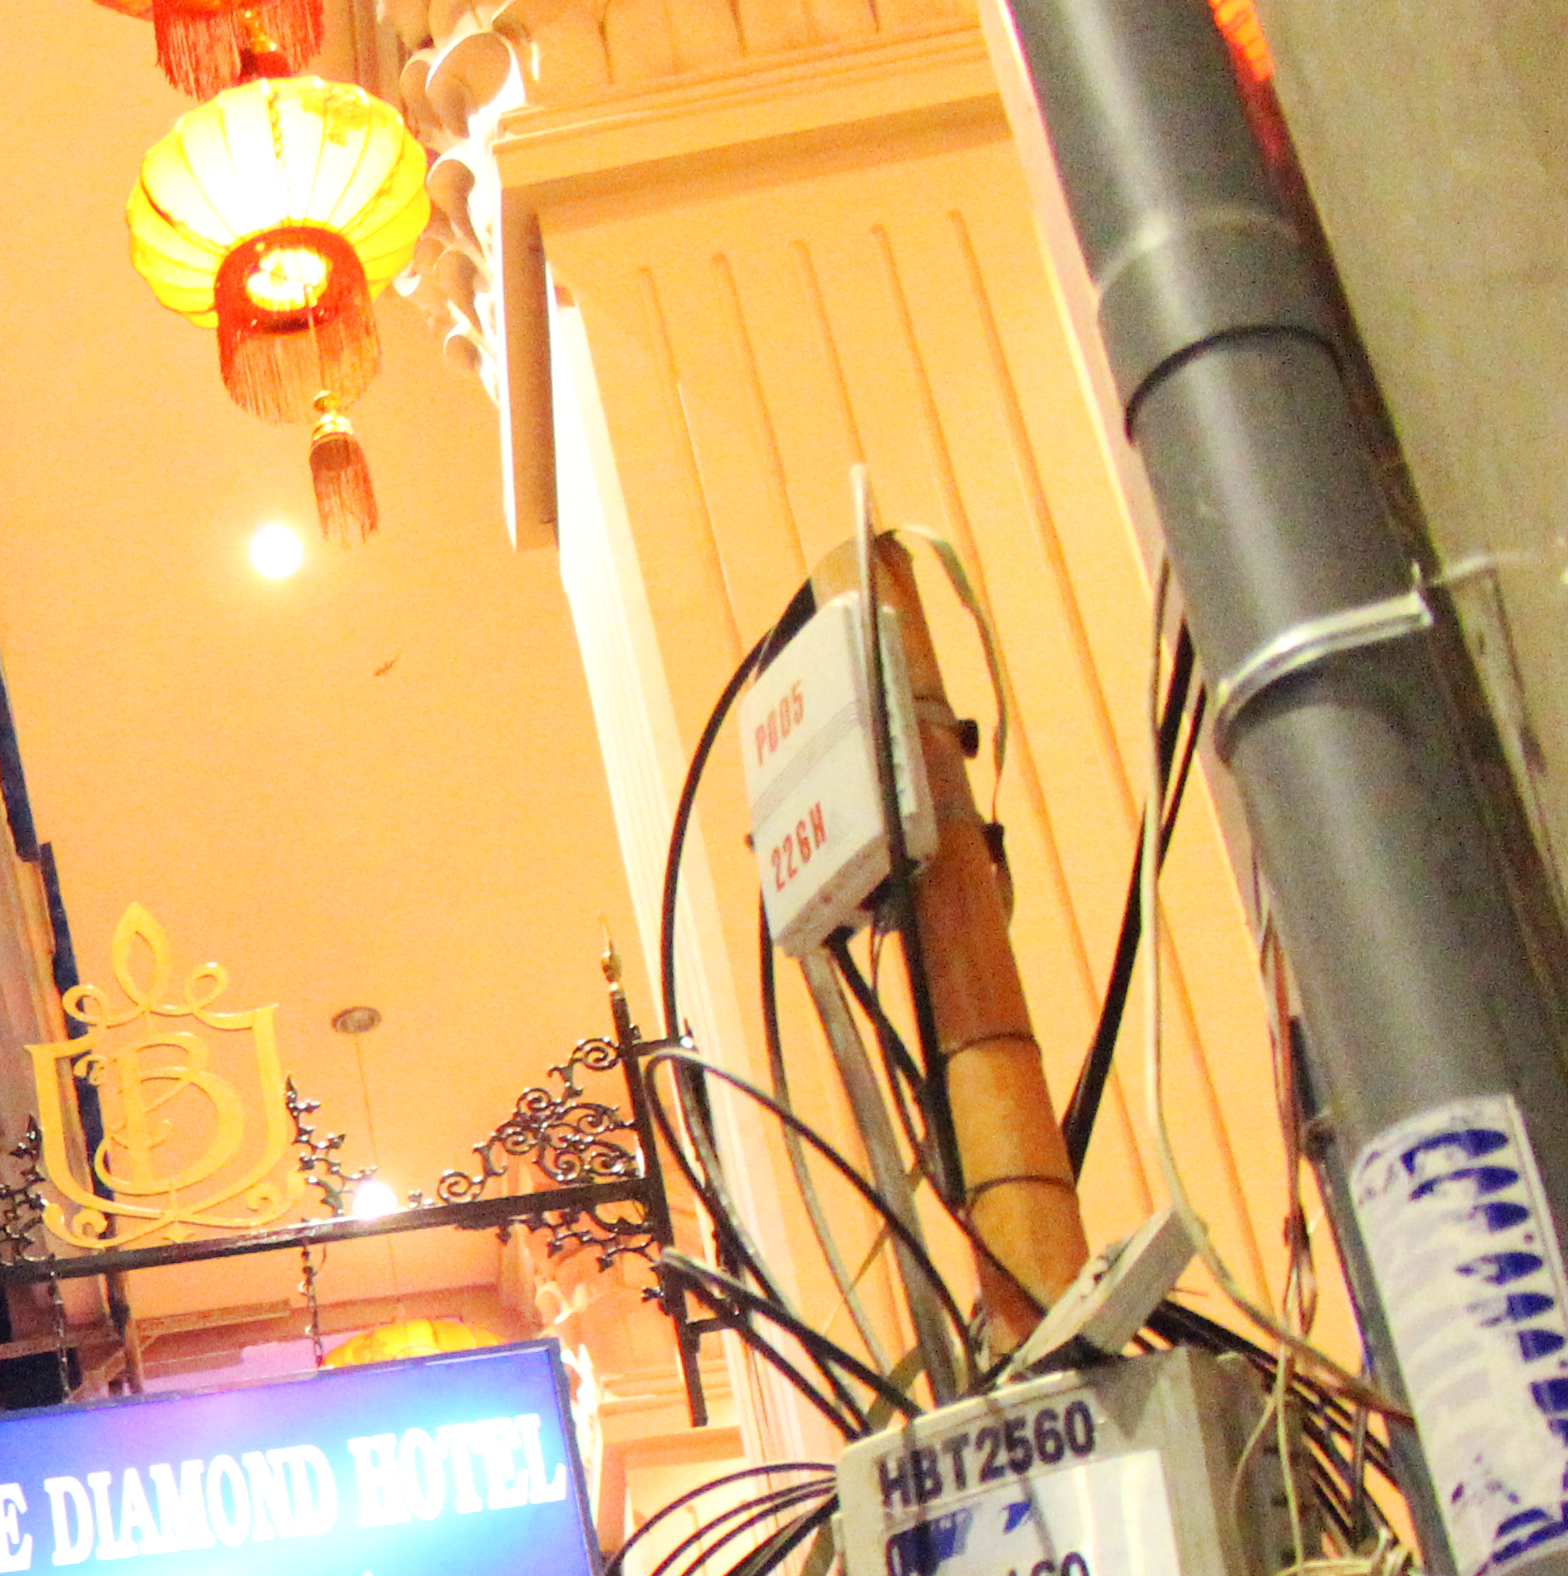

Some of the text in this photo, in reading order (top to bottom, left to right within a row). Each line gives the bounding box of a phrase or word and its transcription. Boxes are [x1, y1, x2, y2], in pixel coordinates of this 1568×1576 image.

[43, 1444, 339, 1567] DIAMOND
[347, 1413, 567, 1529] HOTEL
[878, 1400, 1095, 1508] HBT2560
